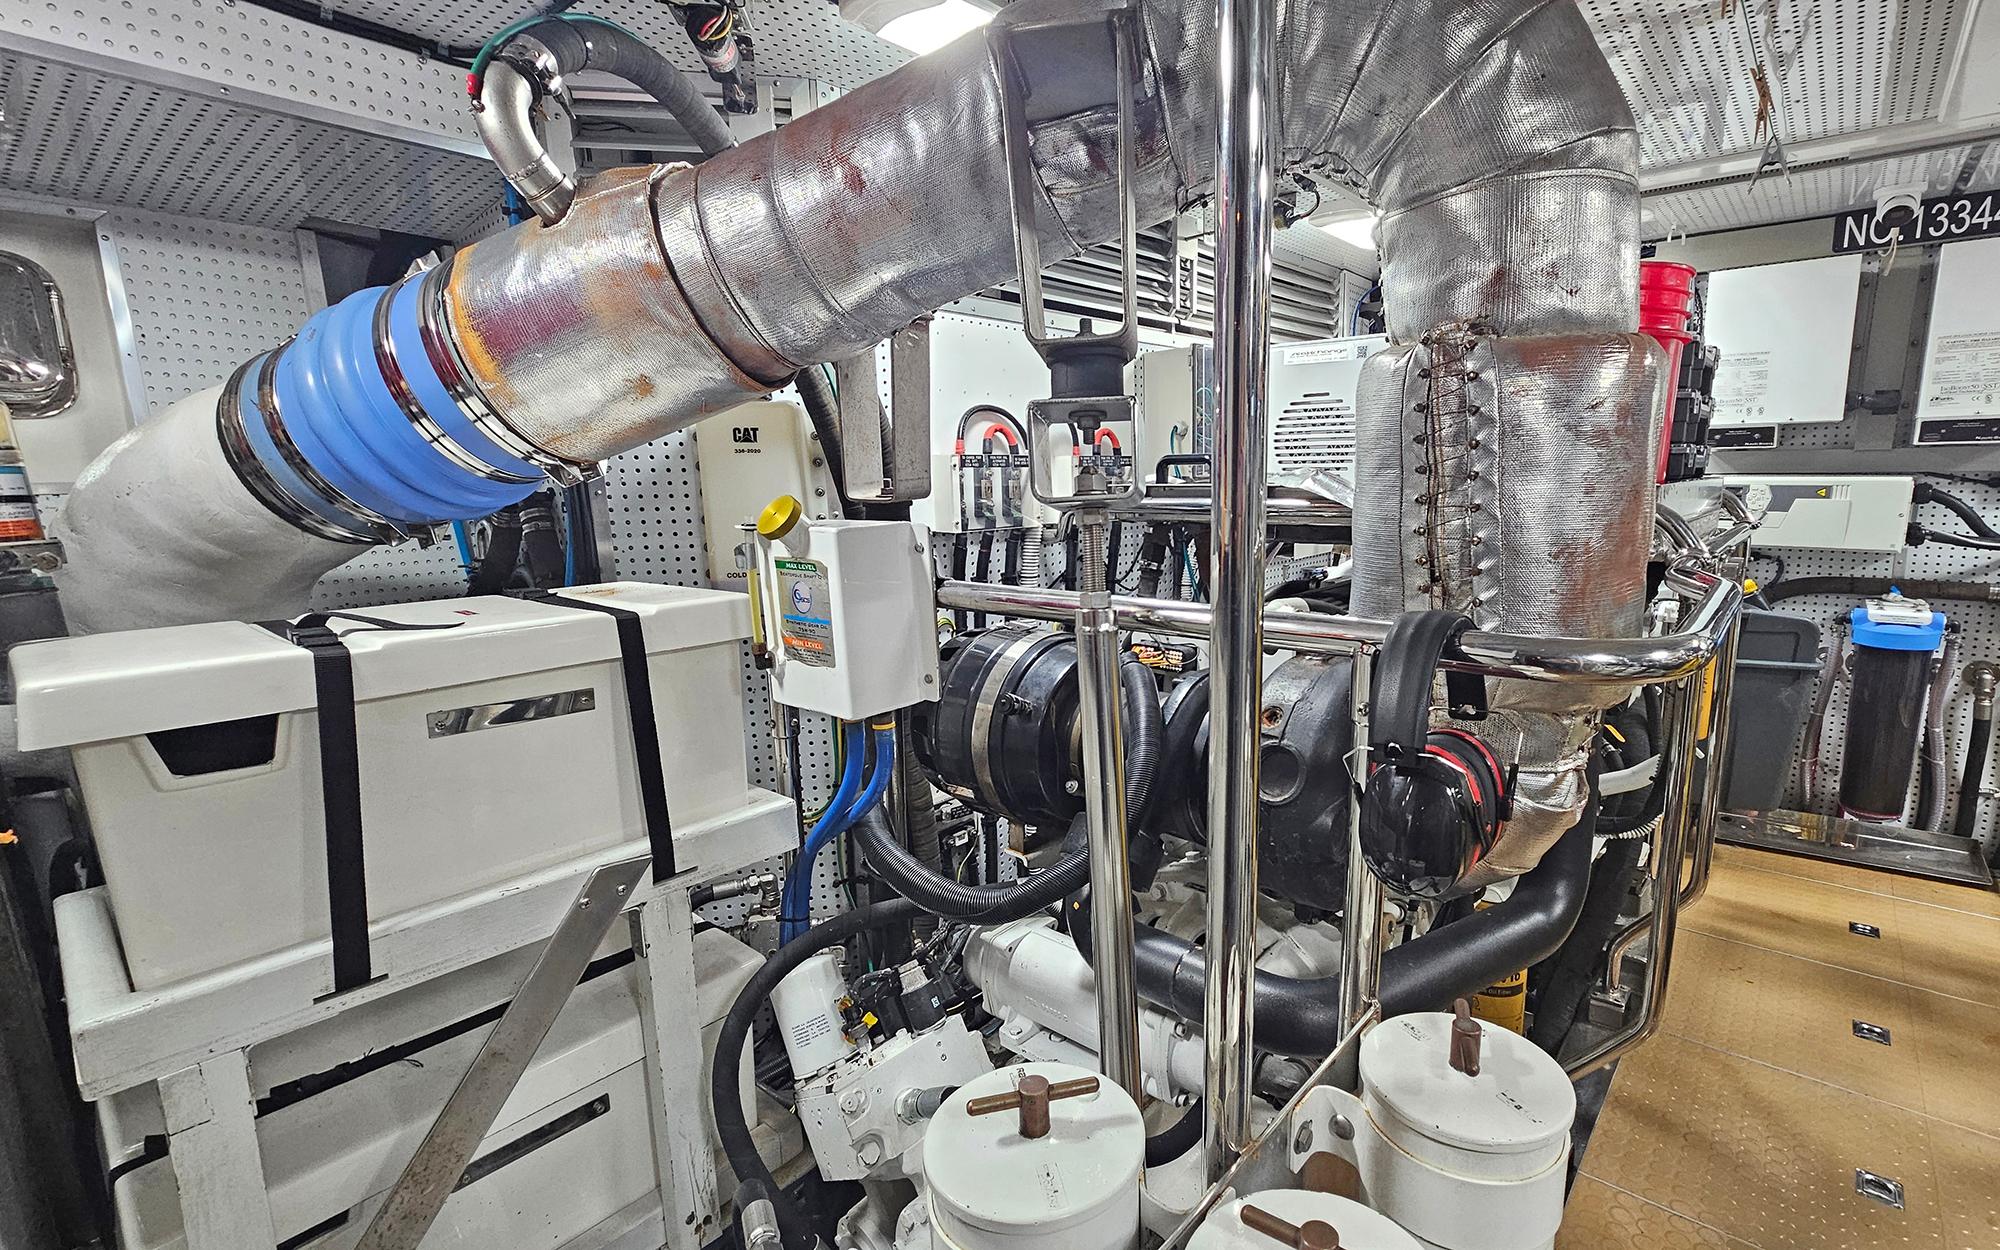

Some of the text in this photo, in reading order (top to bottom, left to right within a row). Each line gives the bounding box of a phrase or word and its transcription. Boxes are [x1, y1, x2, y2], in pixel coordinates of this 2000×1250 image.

[1843, 195, 2000, 248] NO.1334
[733, 427, 759, 443] CAT
[798, 563, 816, 571] LEVEL
[804, 640, 823, 649] LEVEL
